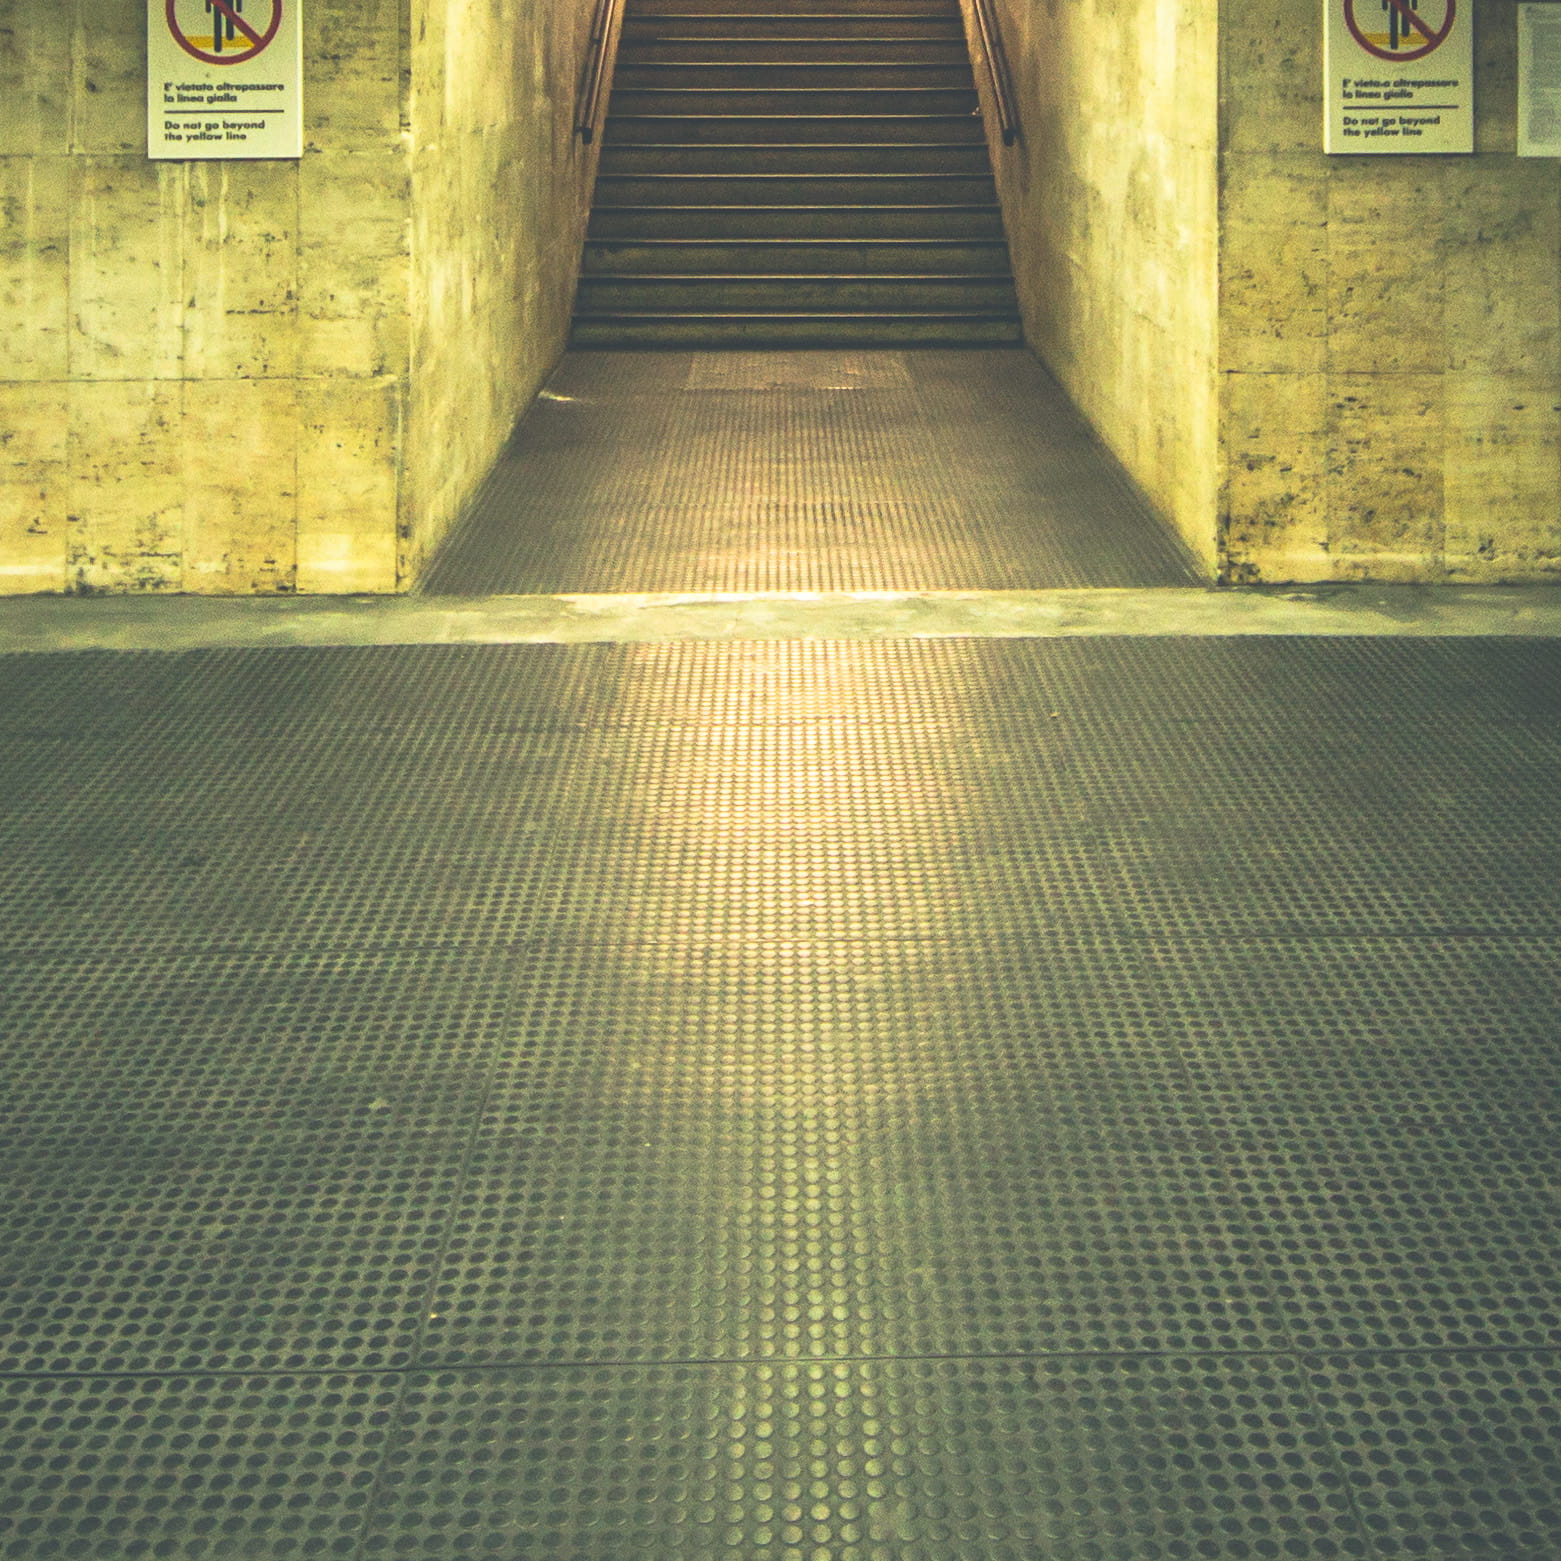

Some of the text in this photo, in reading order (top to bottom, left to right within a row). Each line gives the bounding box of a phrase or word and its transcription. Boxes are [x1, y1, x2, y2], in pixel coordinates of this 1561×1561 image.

[176, 82, 214, 91] vietato
[216, 82, 284, 93] oltrepassare
[1393, 78, 1459, 89] oltrepassare
[164, 93, 237, 105] la linea gialla
[1342, 89, 1414, 101] la linea gialla
[164, 120, 265, 131] Do not go beyond
[1343, 115, 1440, 127] Do not go beyond
[164, 132, 247, 143] the yellow line
[1343, 127, 1422, 139] the yellow line
